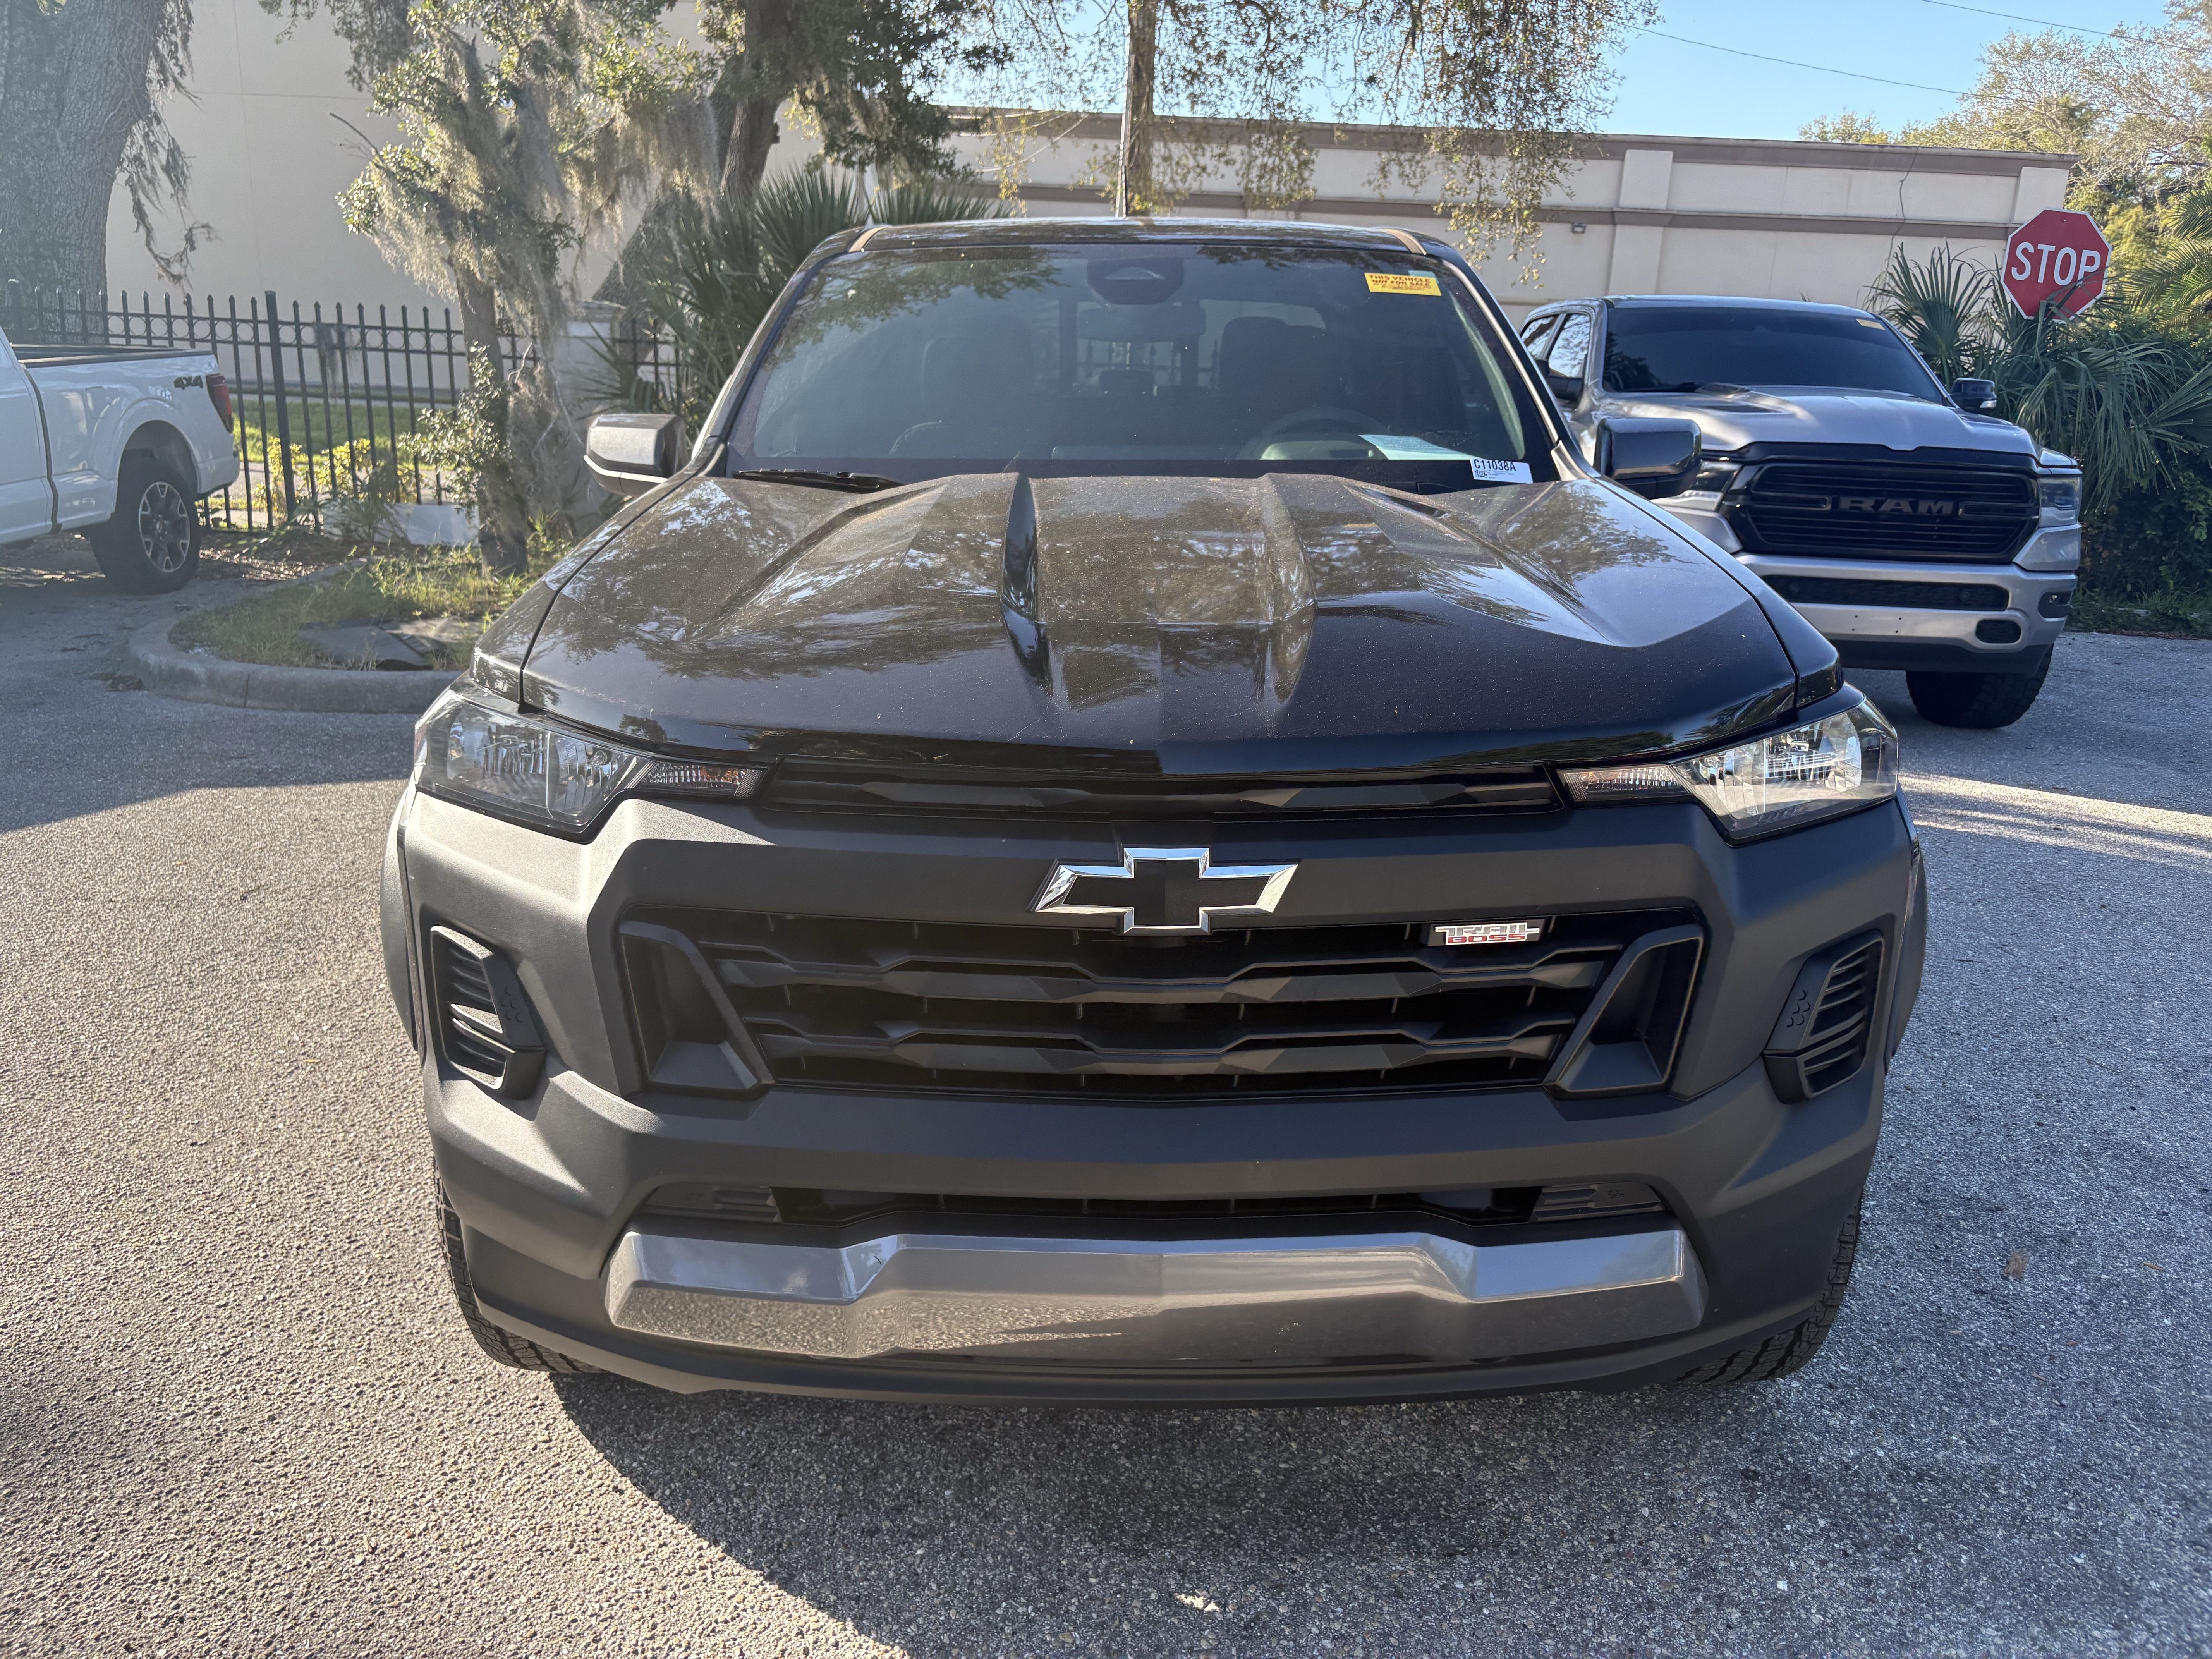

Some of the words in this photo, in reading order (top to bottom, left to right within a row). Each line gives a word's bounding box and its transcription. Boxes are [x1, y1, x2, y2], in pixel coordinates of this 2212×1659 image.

[2011, 242, 2101, 287] STOP
[1474, 459, 1516, 472] C11038A
[1838, 496, 1954, 515] RAM
[1435, 922, 1540, 936] TRAIL
[1448, 933, 1526, 944] BOSS
